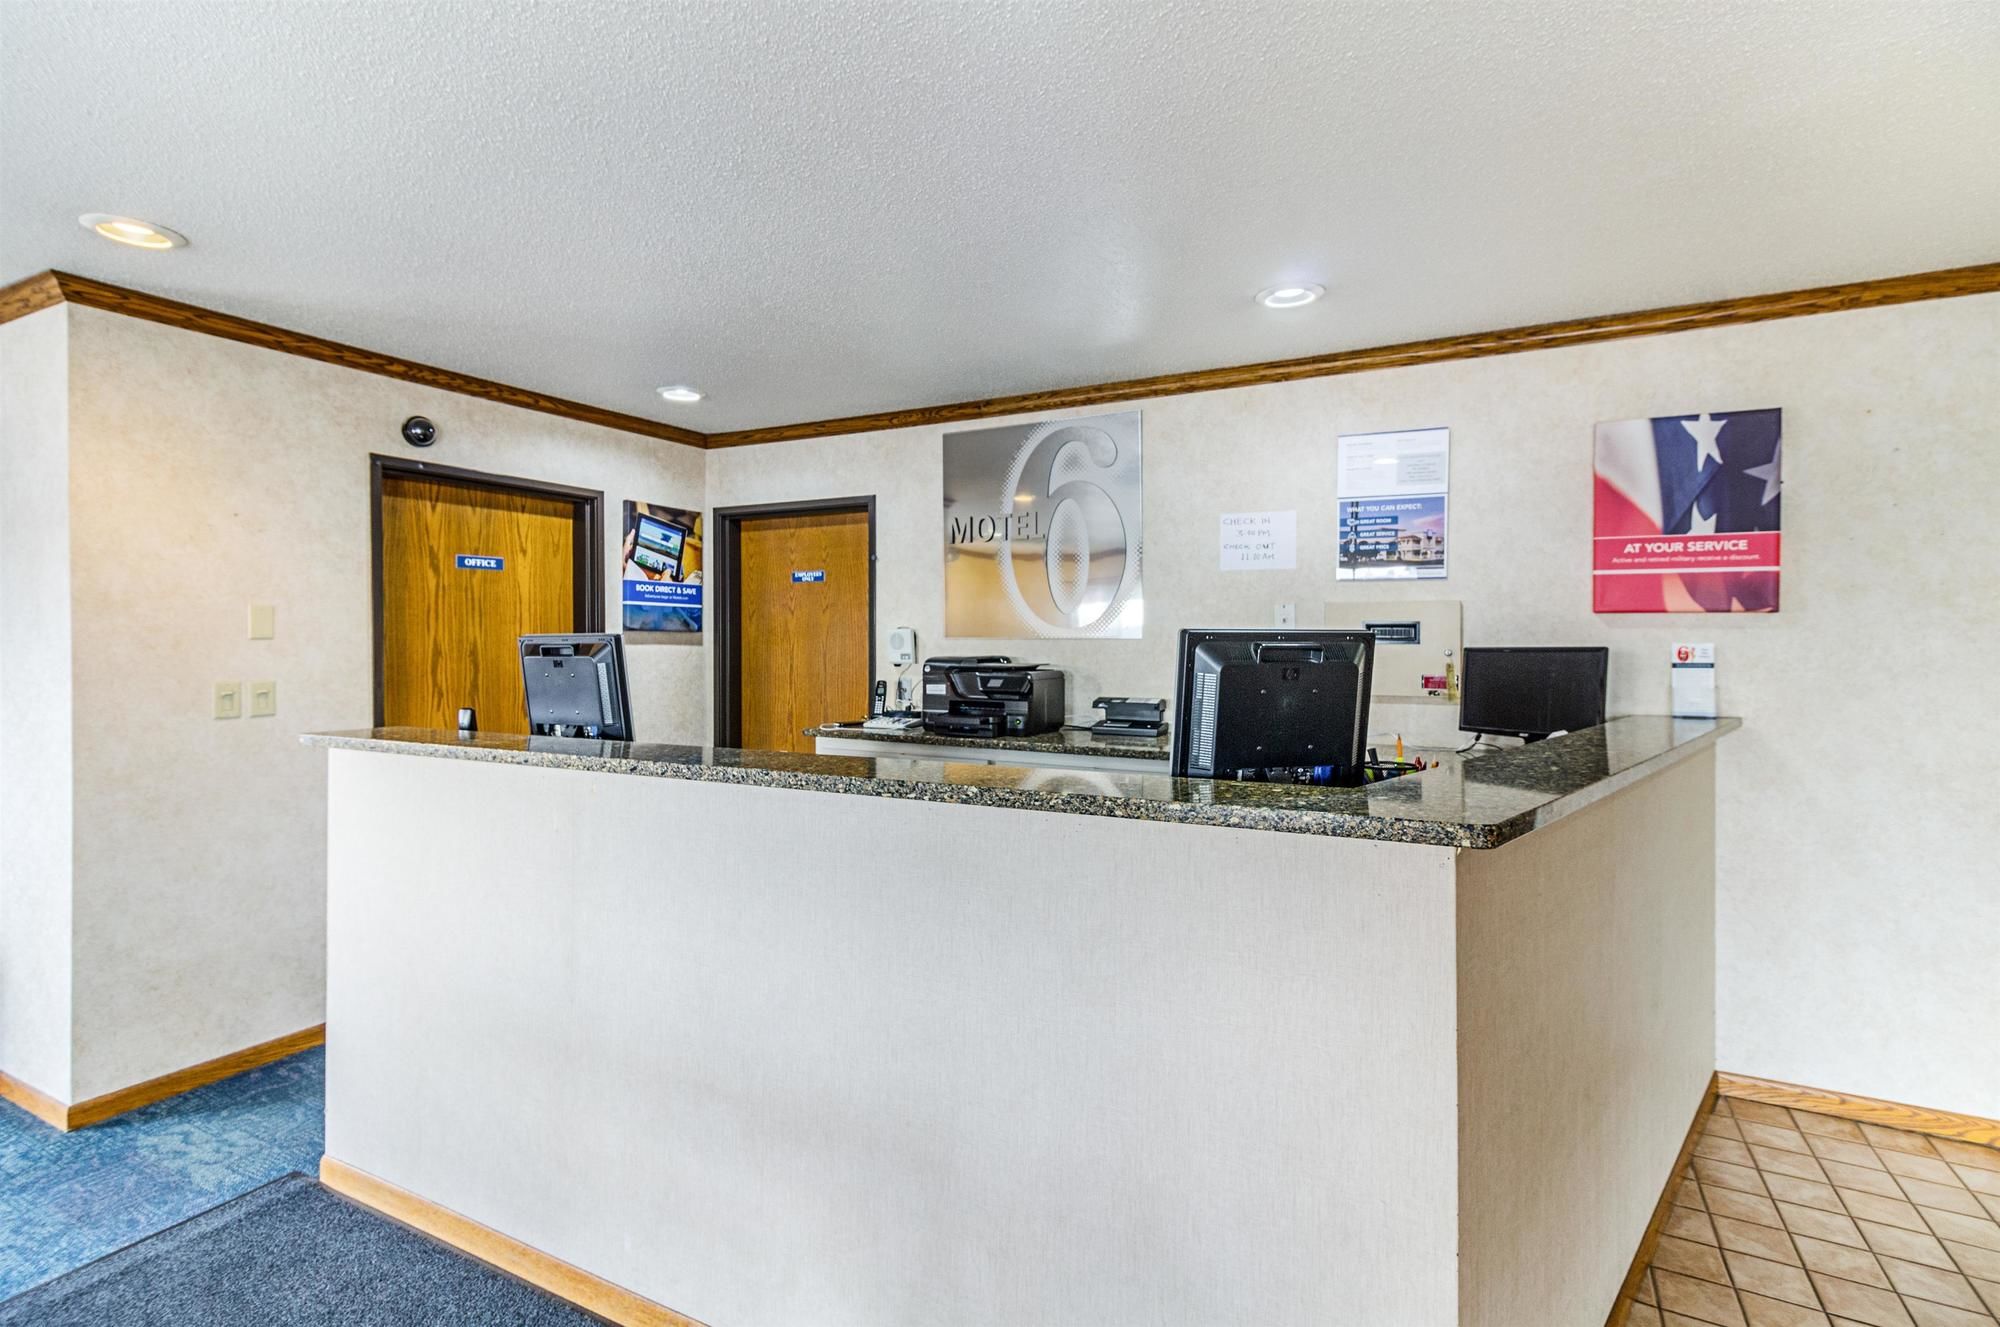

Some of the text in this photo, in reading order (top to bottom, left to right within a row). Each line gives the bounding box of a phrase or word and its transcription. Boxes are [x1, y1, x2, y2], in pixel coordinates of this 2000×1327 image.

[1366, 504, 1379, 512] YOU
[1381, 503, 1395, 511] CAN
[951, 425, 1127, 630] MOTEL 6
[1623, 539, 1749, 554] AT YOUR SERVICE
[464, 557, 497, 568] OFFICE
[635, 584, 655, 592] BOOK
[682, 587, 697, 595] SAVE
